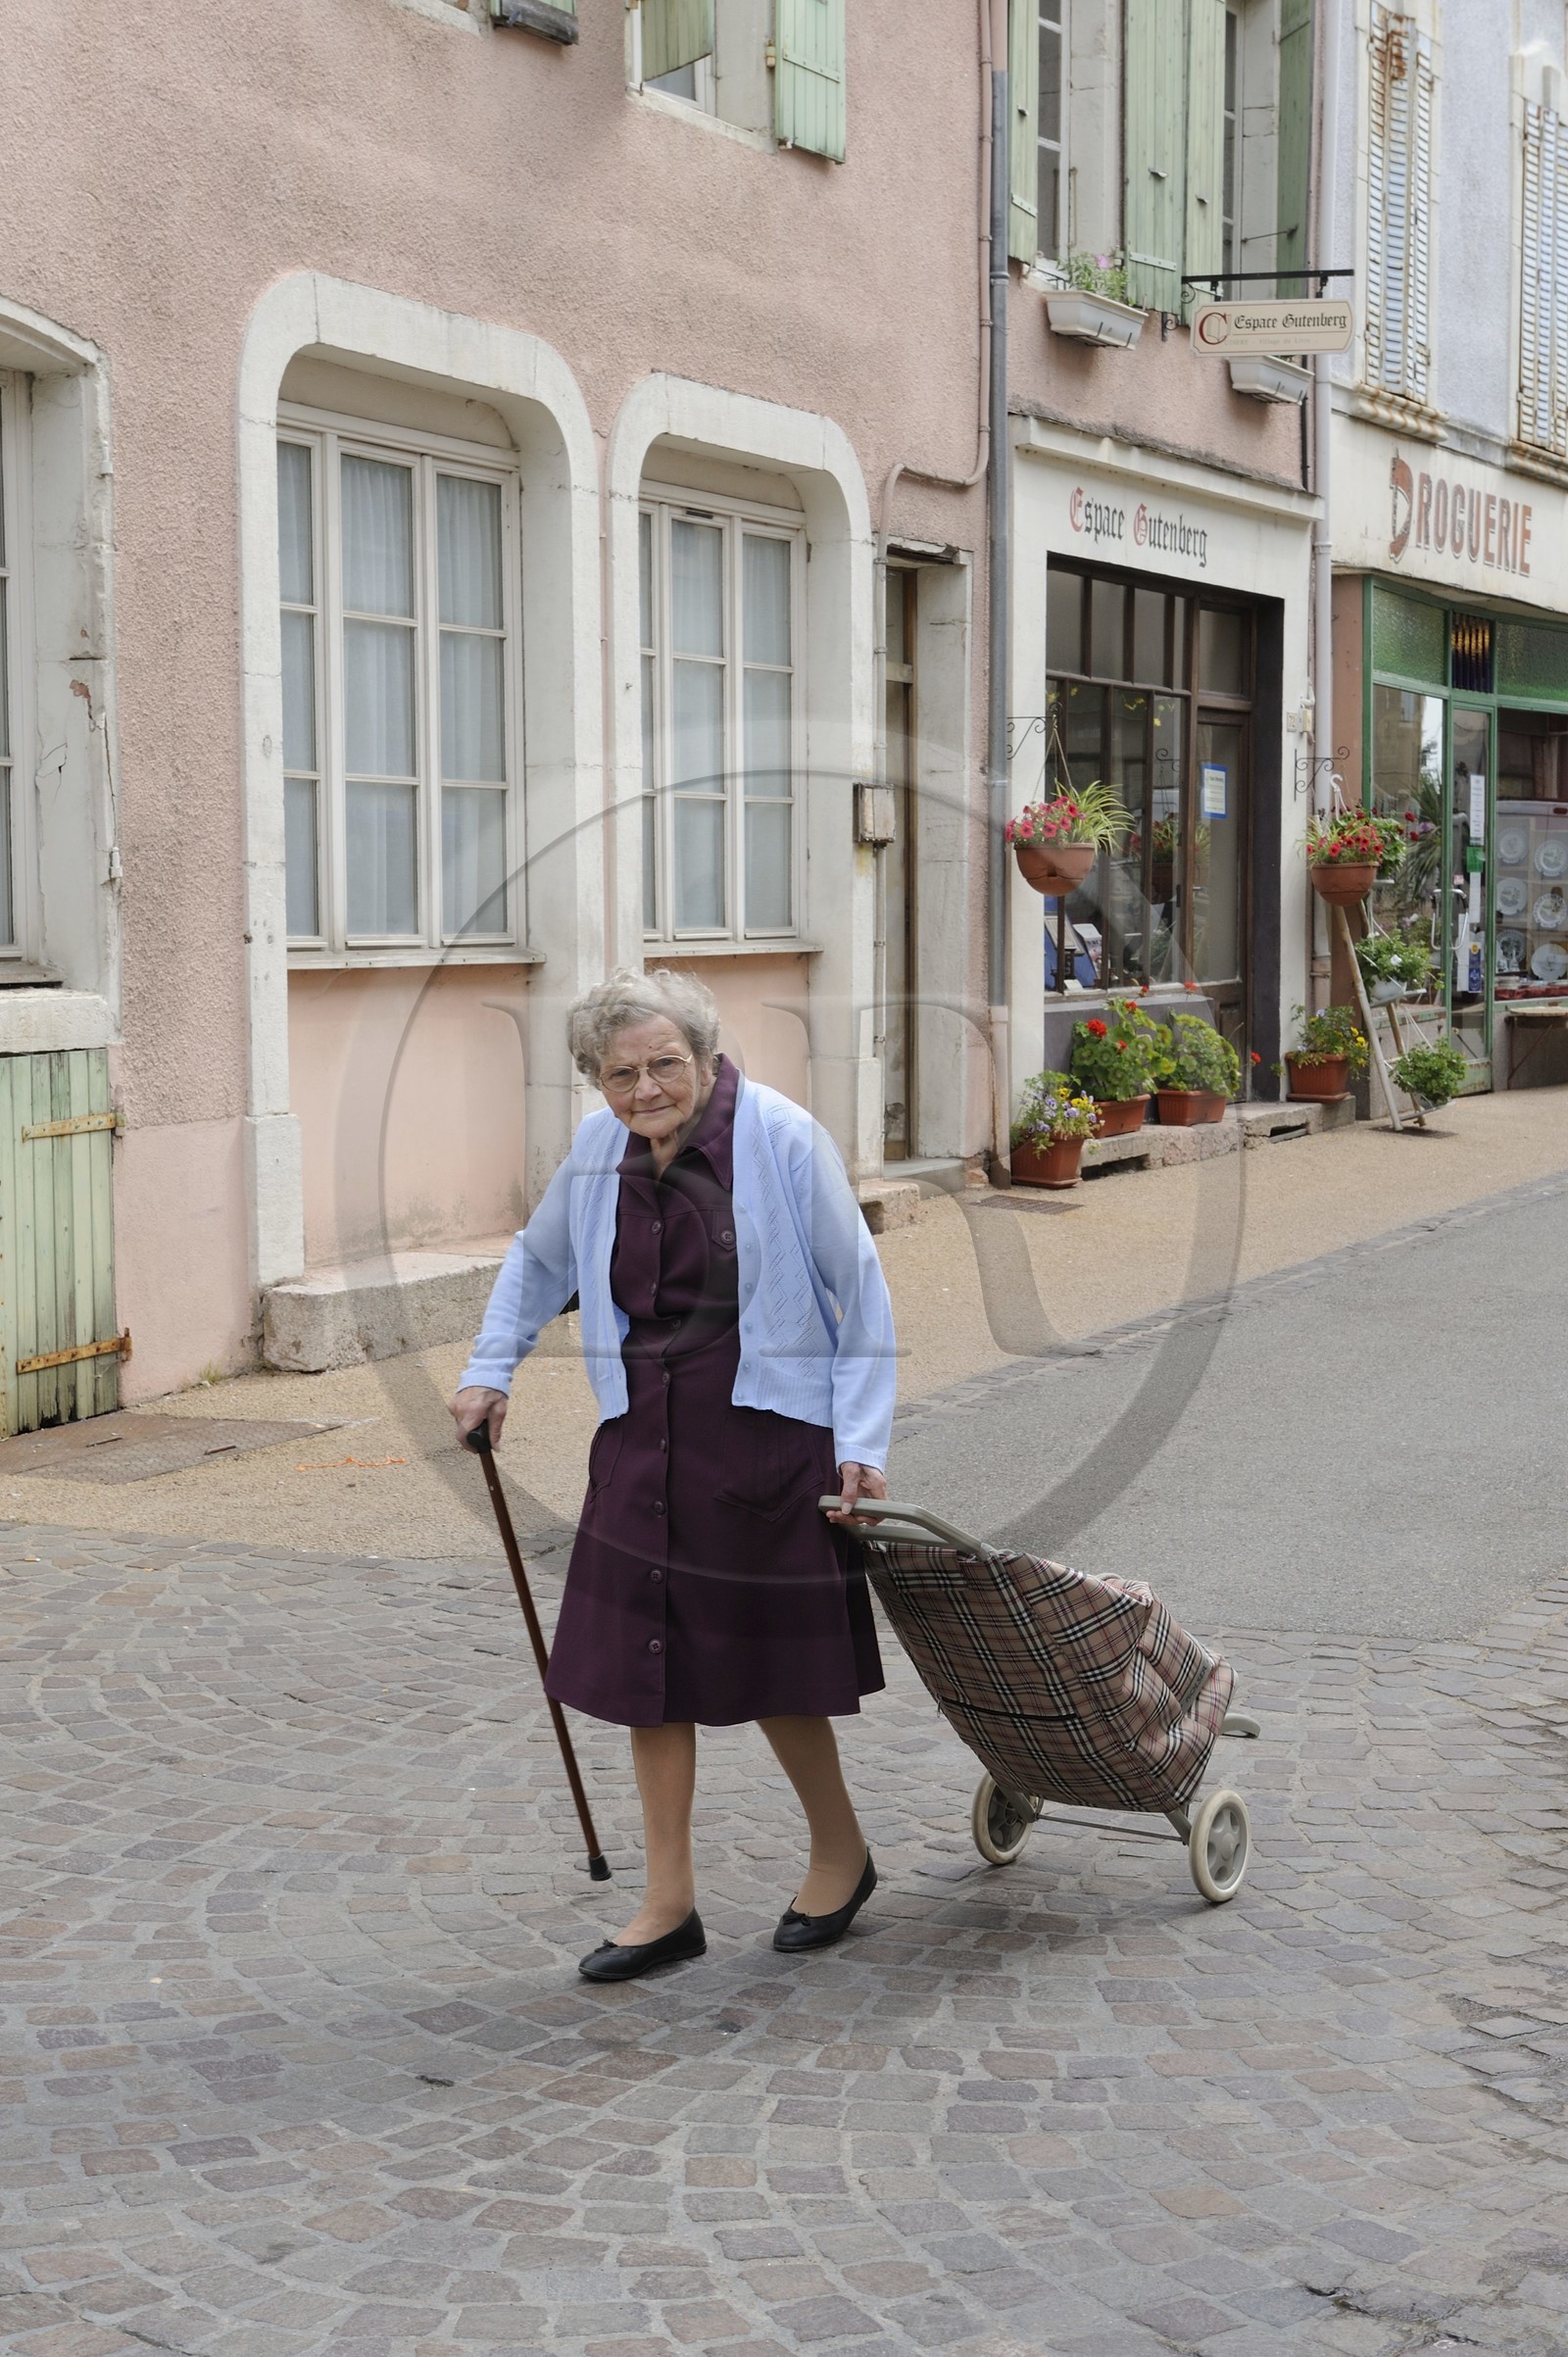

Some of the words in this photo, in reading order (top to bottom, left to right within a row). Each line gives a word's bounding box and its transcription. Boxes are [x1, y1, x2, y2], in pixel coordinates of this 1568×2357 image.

[1234, 315, 1278, 331] Espace
[1282, 313, 1348, 329] Gutenberg
[1069, 486, 1125, 545] Espace
[1133, 503, 1208, 568] Gutenberg
[1388, 447, 1533, 578] DROGUERIE
[1185, 1665, 1208, 1703] ROLSER
